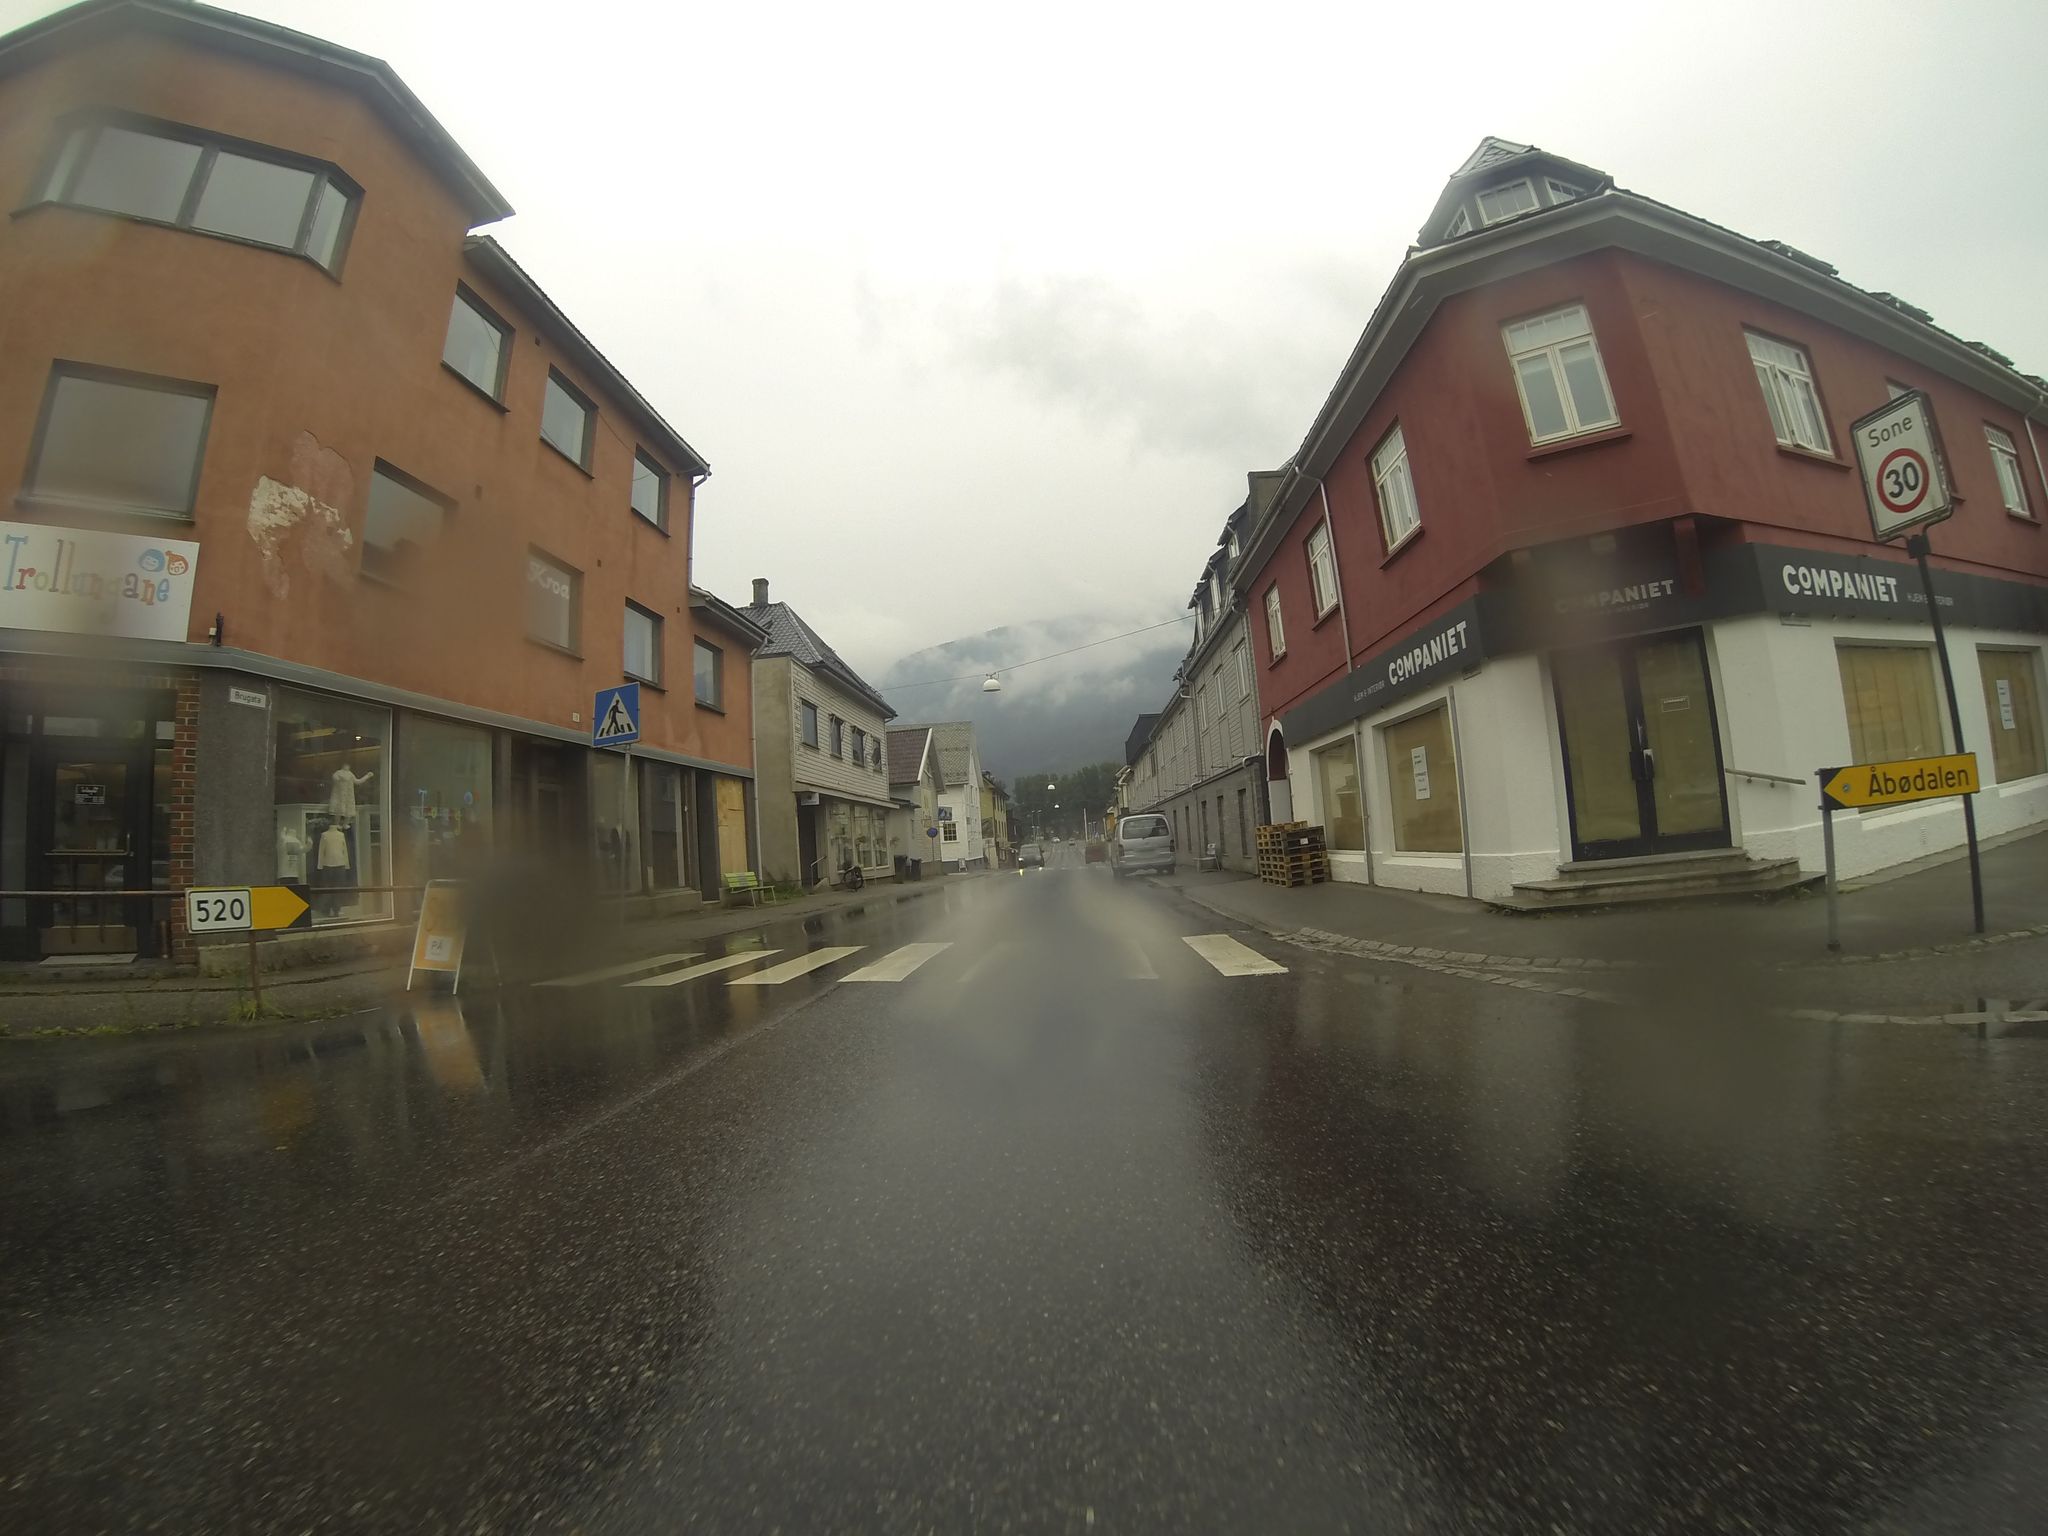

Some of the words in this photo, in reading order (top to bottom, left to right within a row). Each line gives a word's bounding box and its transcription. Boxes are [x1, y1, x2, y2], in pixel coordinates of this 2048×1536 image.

[1868, 417, 1913, 448] Sone
[1885, 462, 1919, 498] 30
[1554, 579, 1674, 614] CMPANIET
[1782, 564, 1898, 602] COMPANIET
[1388, 620, 1467, 685] COMPANIET
[1869, 766, 1969, 797] Åbødalen
[196, 897, 245, 923] 520
